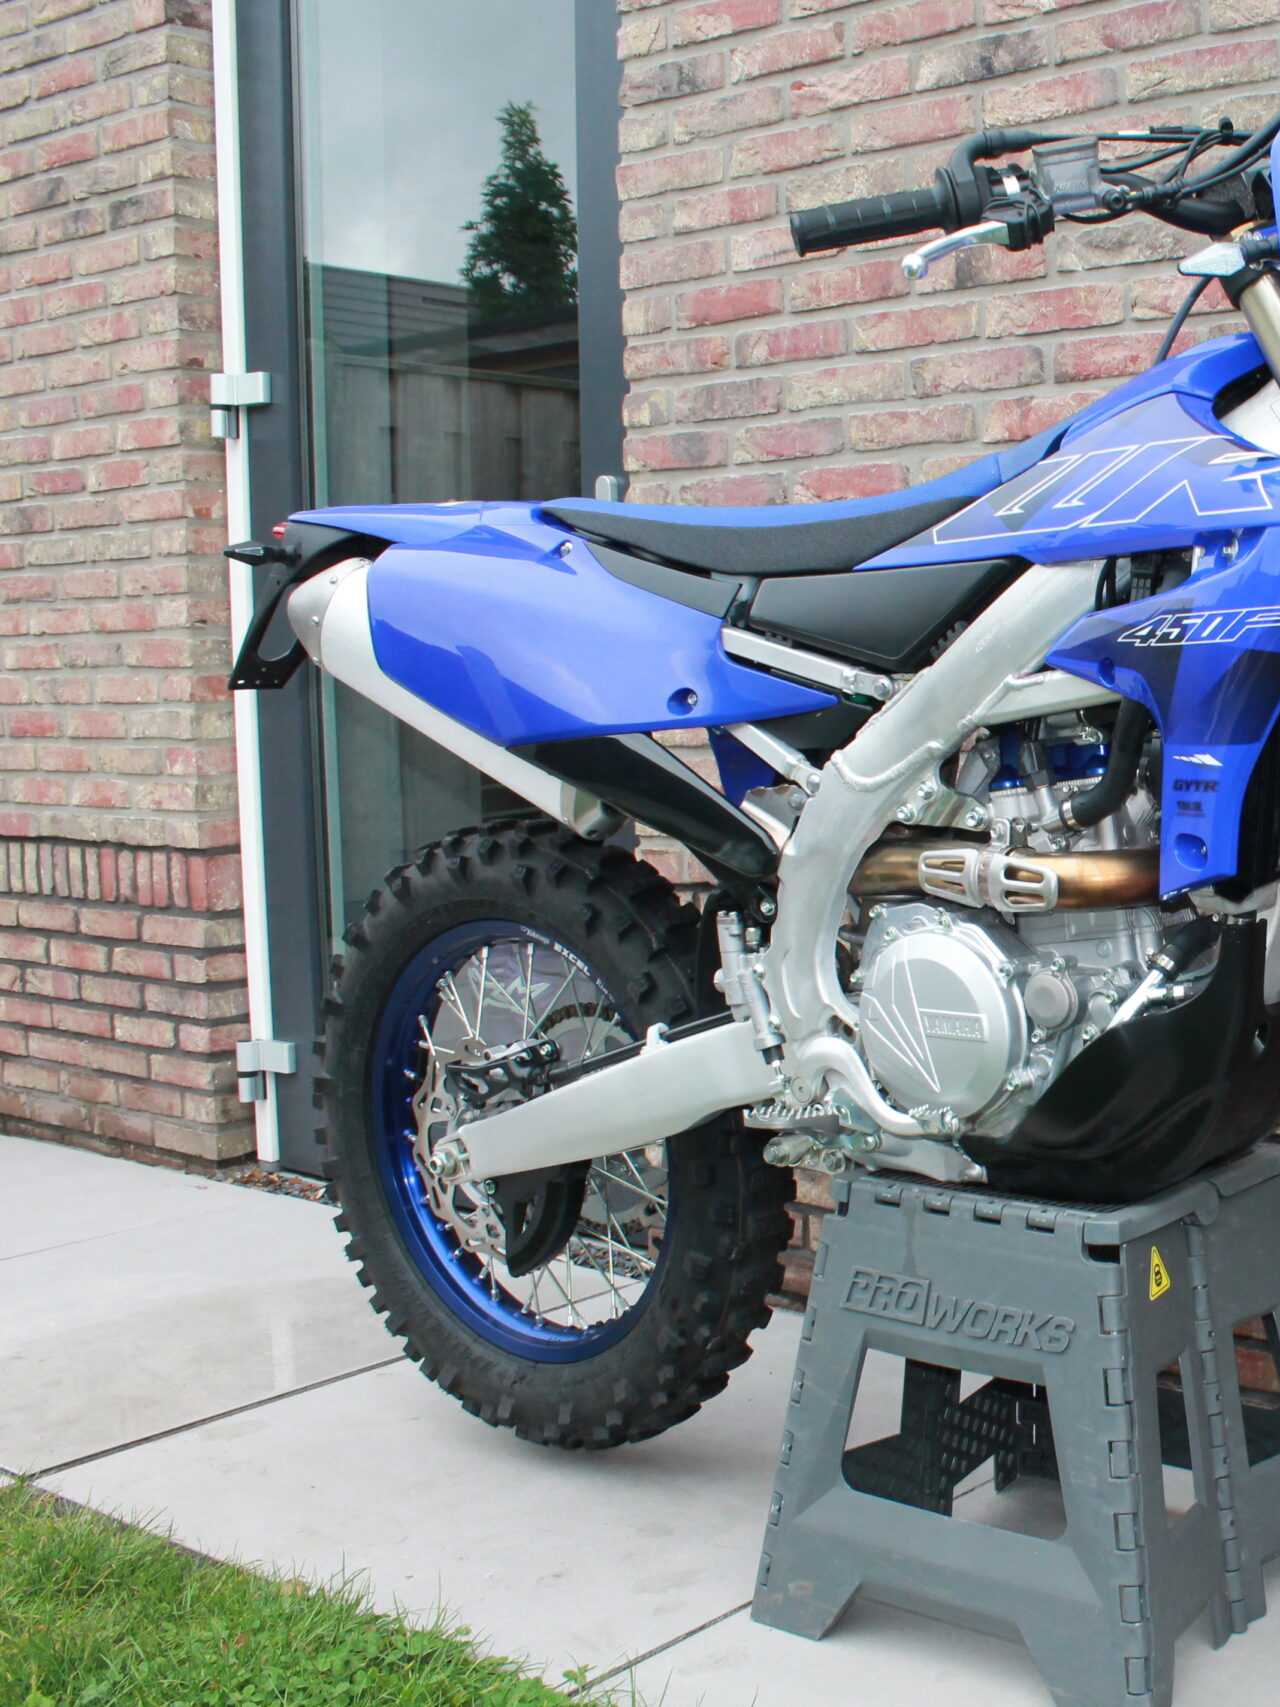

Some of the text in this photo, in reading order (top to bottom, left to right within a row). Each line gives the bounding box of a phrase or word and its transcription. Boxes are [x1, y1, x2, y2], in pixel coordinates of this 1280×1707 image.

[1172, 778, 1221, 793] GYTR
[553, 941, 591, 977] EXCEL
[924, 1014, 982, 1039] YAMAHA
